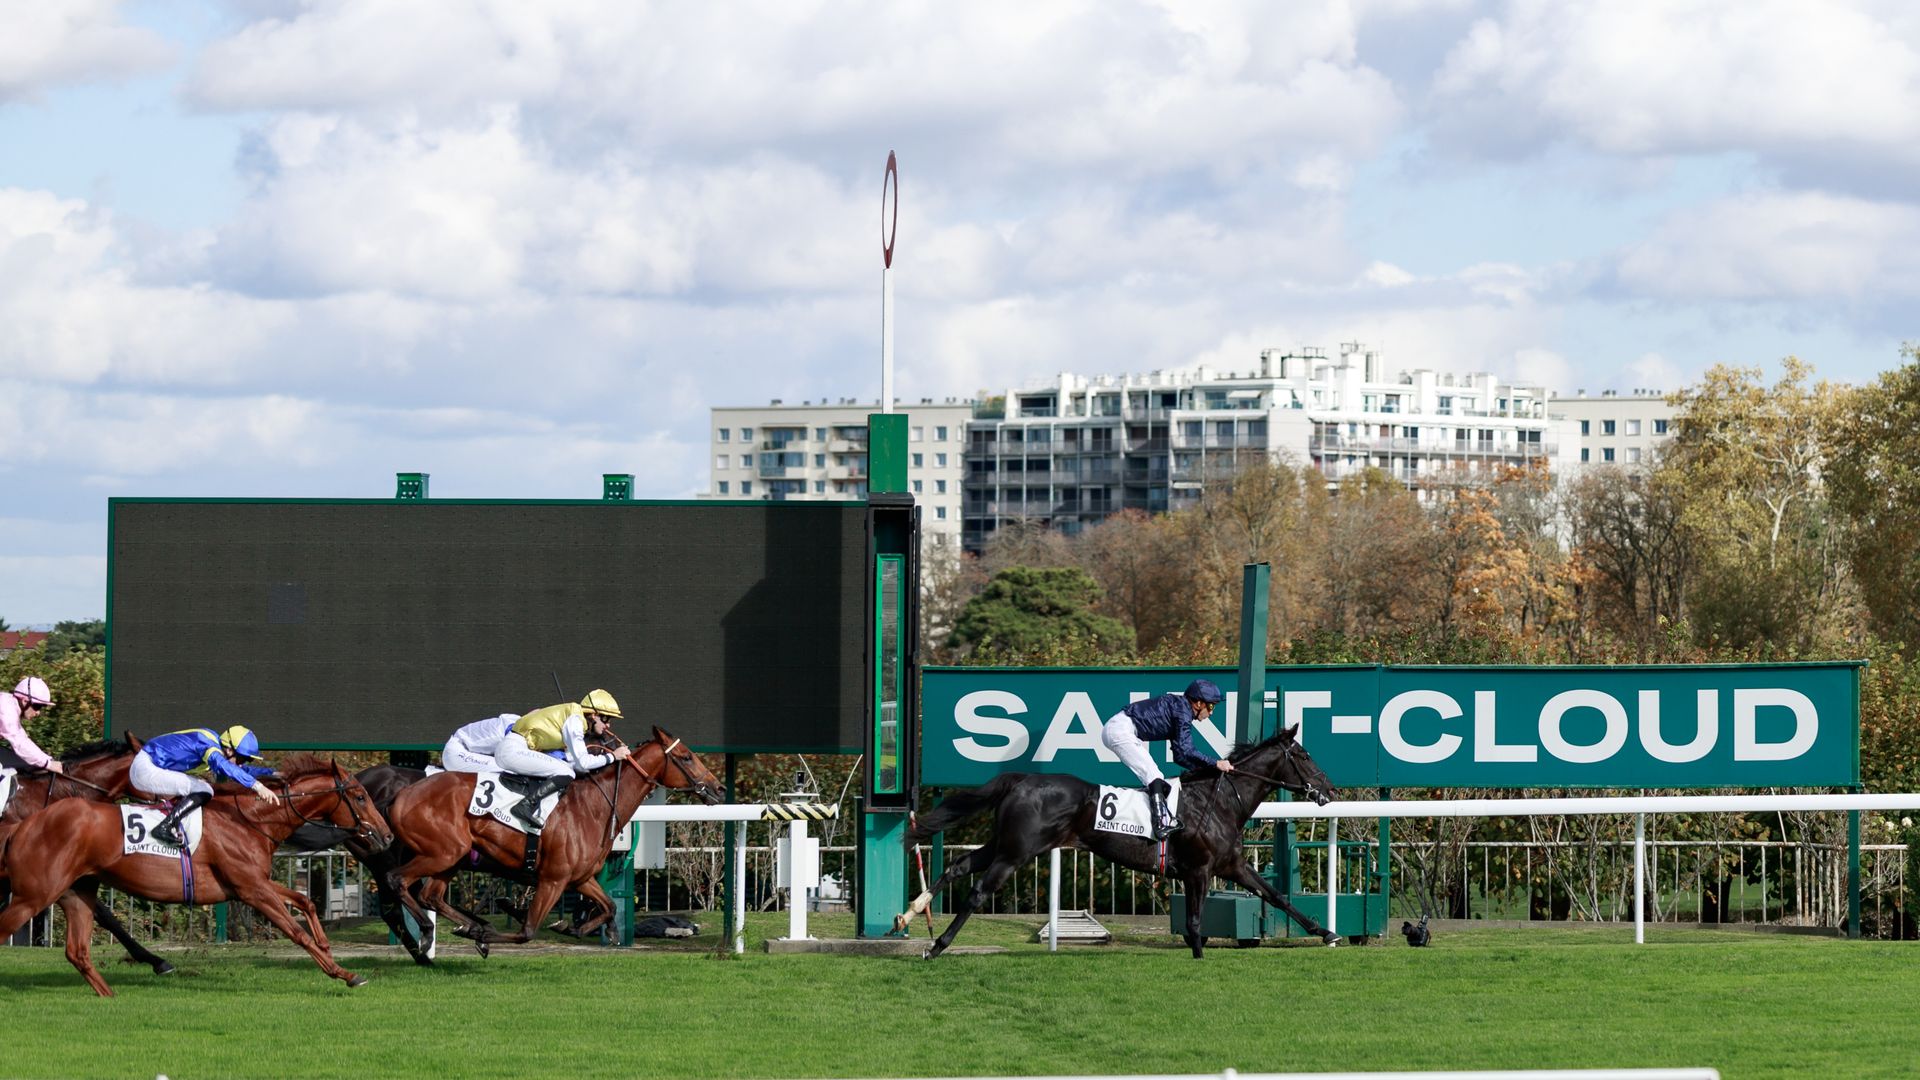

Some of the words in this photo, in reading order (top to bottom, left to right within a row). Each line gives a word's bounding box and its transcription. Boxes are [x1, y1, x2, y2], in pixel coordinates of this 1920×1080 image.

[952, 688, 1819, 763] SANT-CLOUD
[475, 780, 496, 809] 3
[1100, 792, 1119, 821] 6
[126, 813, 146, 844] 5
[1097, 821, 1120, 831] SAINT
[1120, 823, 1145, 834] CLOUD
[126, 843, 150, 852] SAINT
[151, 845, 178, 856] CLOUD
